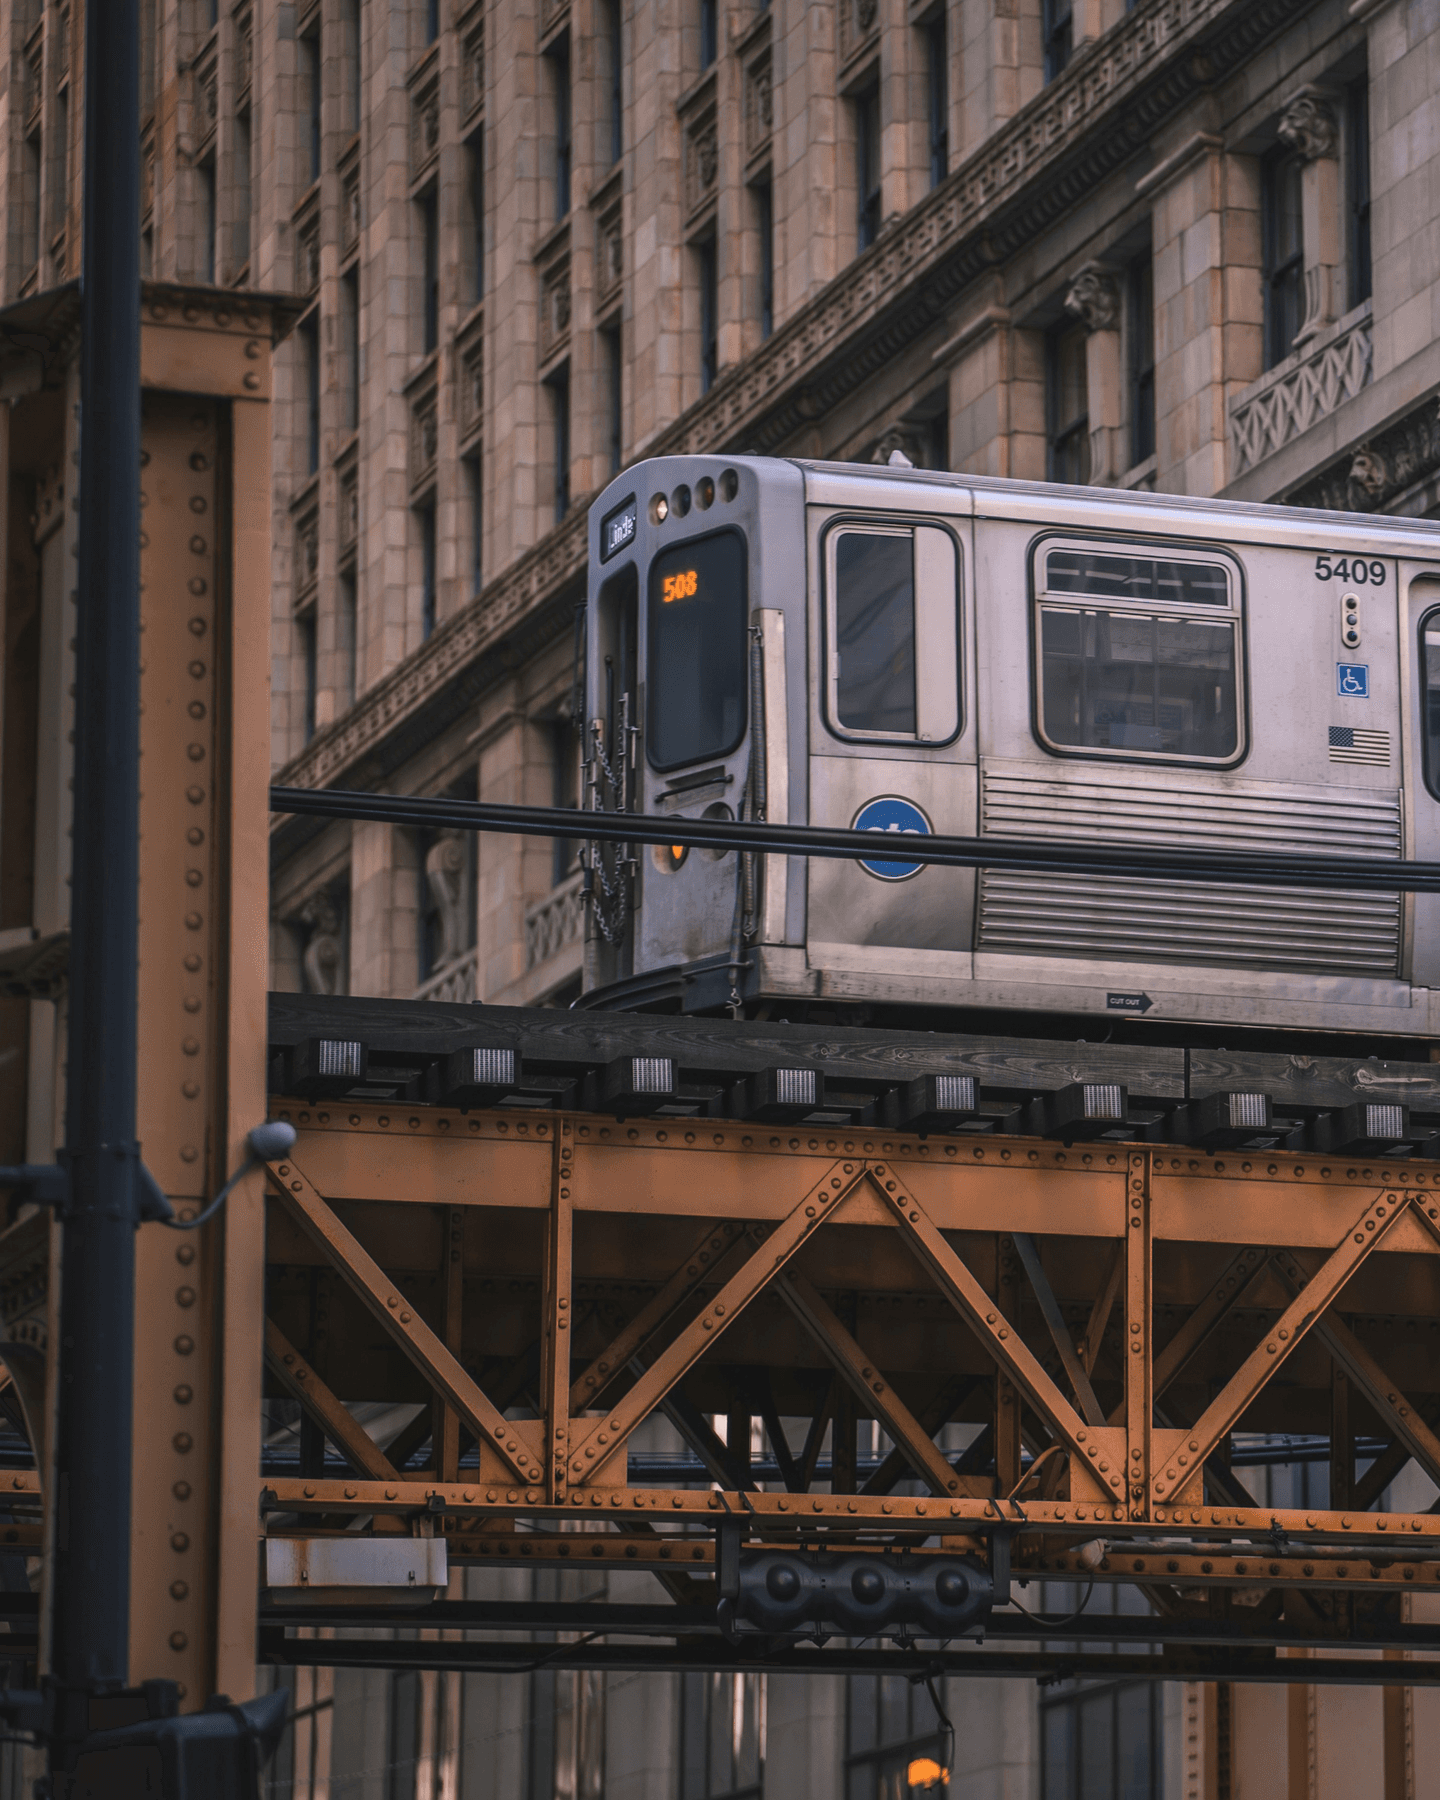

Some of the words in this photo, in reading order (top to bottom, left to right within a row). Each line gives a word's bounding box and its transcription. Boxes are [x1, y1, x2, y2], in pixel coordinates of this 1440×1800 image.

[1314, 555, 1386, 586] 5409
[663, 570, 698, 603] 508
[1110, 997, 1125, 1005] CUT
[1125, 998, 1140, 1006] OUT
